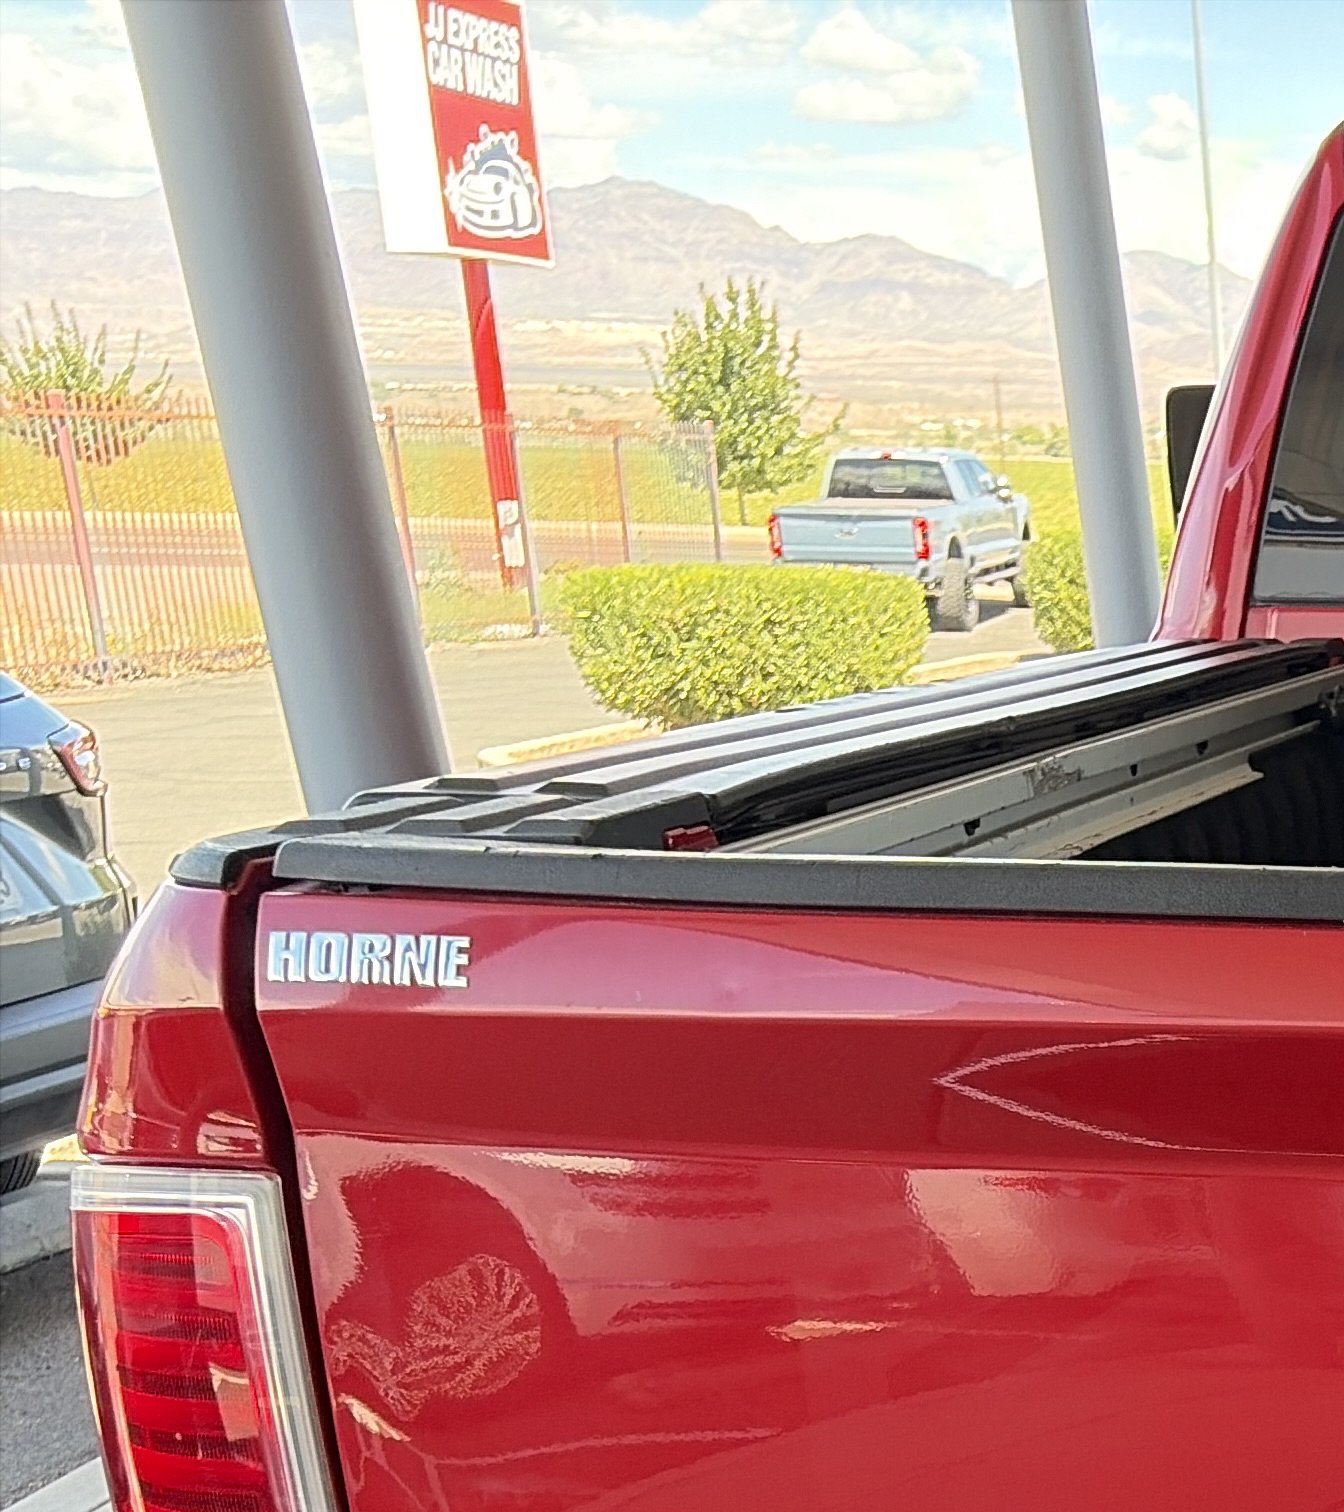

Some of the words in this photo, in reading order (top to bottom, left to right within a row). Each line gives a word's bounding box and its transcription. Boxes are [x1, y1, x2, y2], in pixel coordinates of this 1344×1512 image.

[446, 6, 521, 63] EXPRESS
[427, 40, 464, 92] CAR
[464, 51, 519, 105] WASH
[267, 931, 471, 988] HORNE
